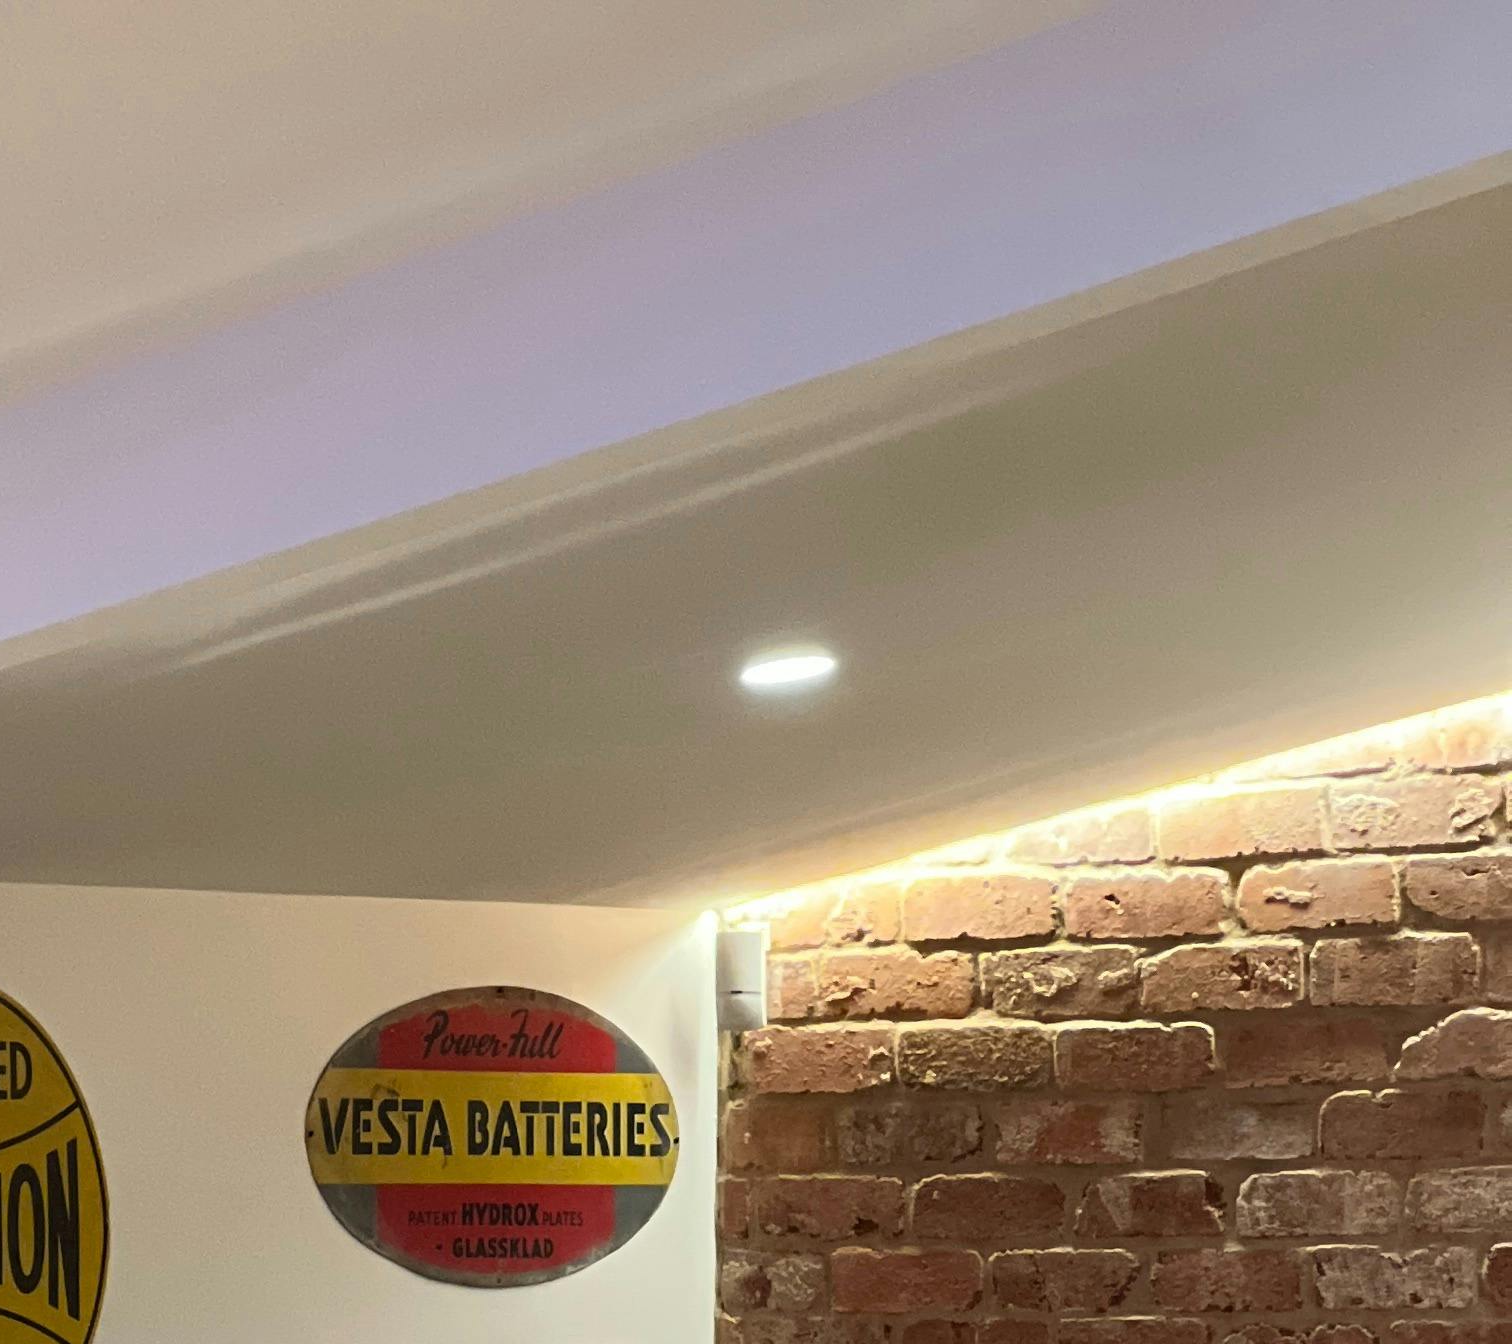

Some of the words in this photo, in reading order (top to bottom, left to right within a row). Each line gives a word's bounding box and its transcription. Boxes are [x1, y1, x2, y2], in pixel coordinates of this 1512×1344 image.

[318, 1096, 453, 1157] VESTA
[467, 1098, 672, 1158] BATTERIES
[407, 1210, 457, 1227] PATENT
[461, 1203, 540, 1227] HYDROX
[542, 1211, 584, 1228] PLATES
[452, 1238, 554, 1260] GLASSKLAD
